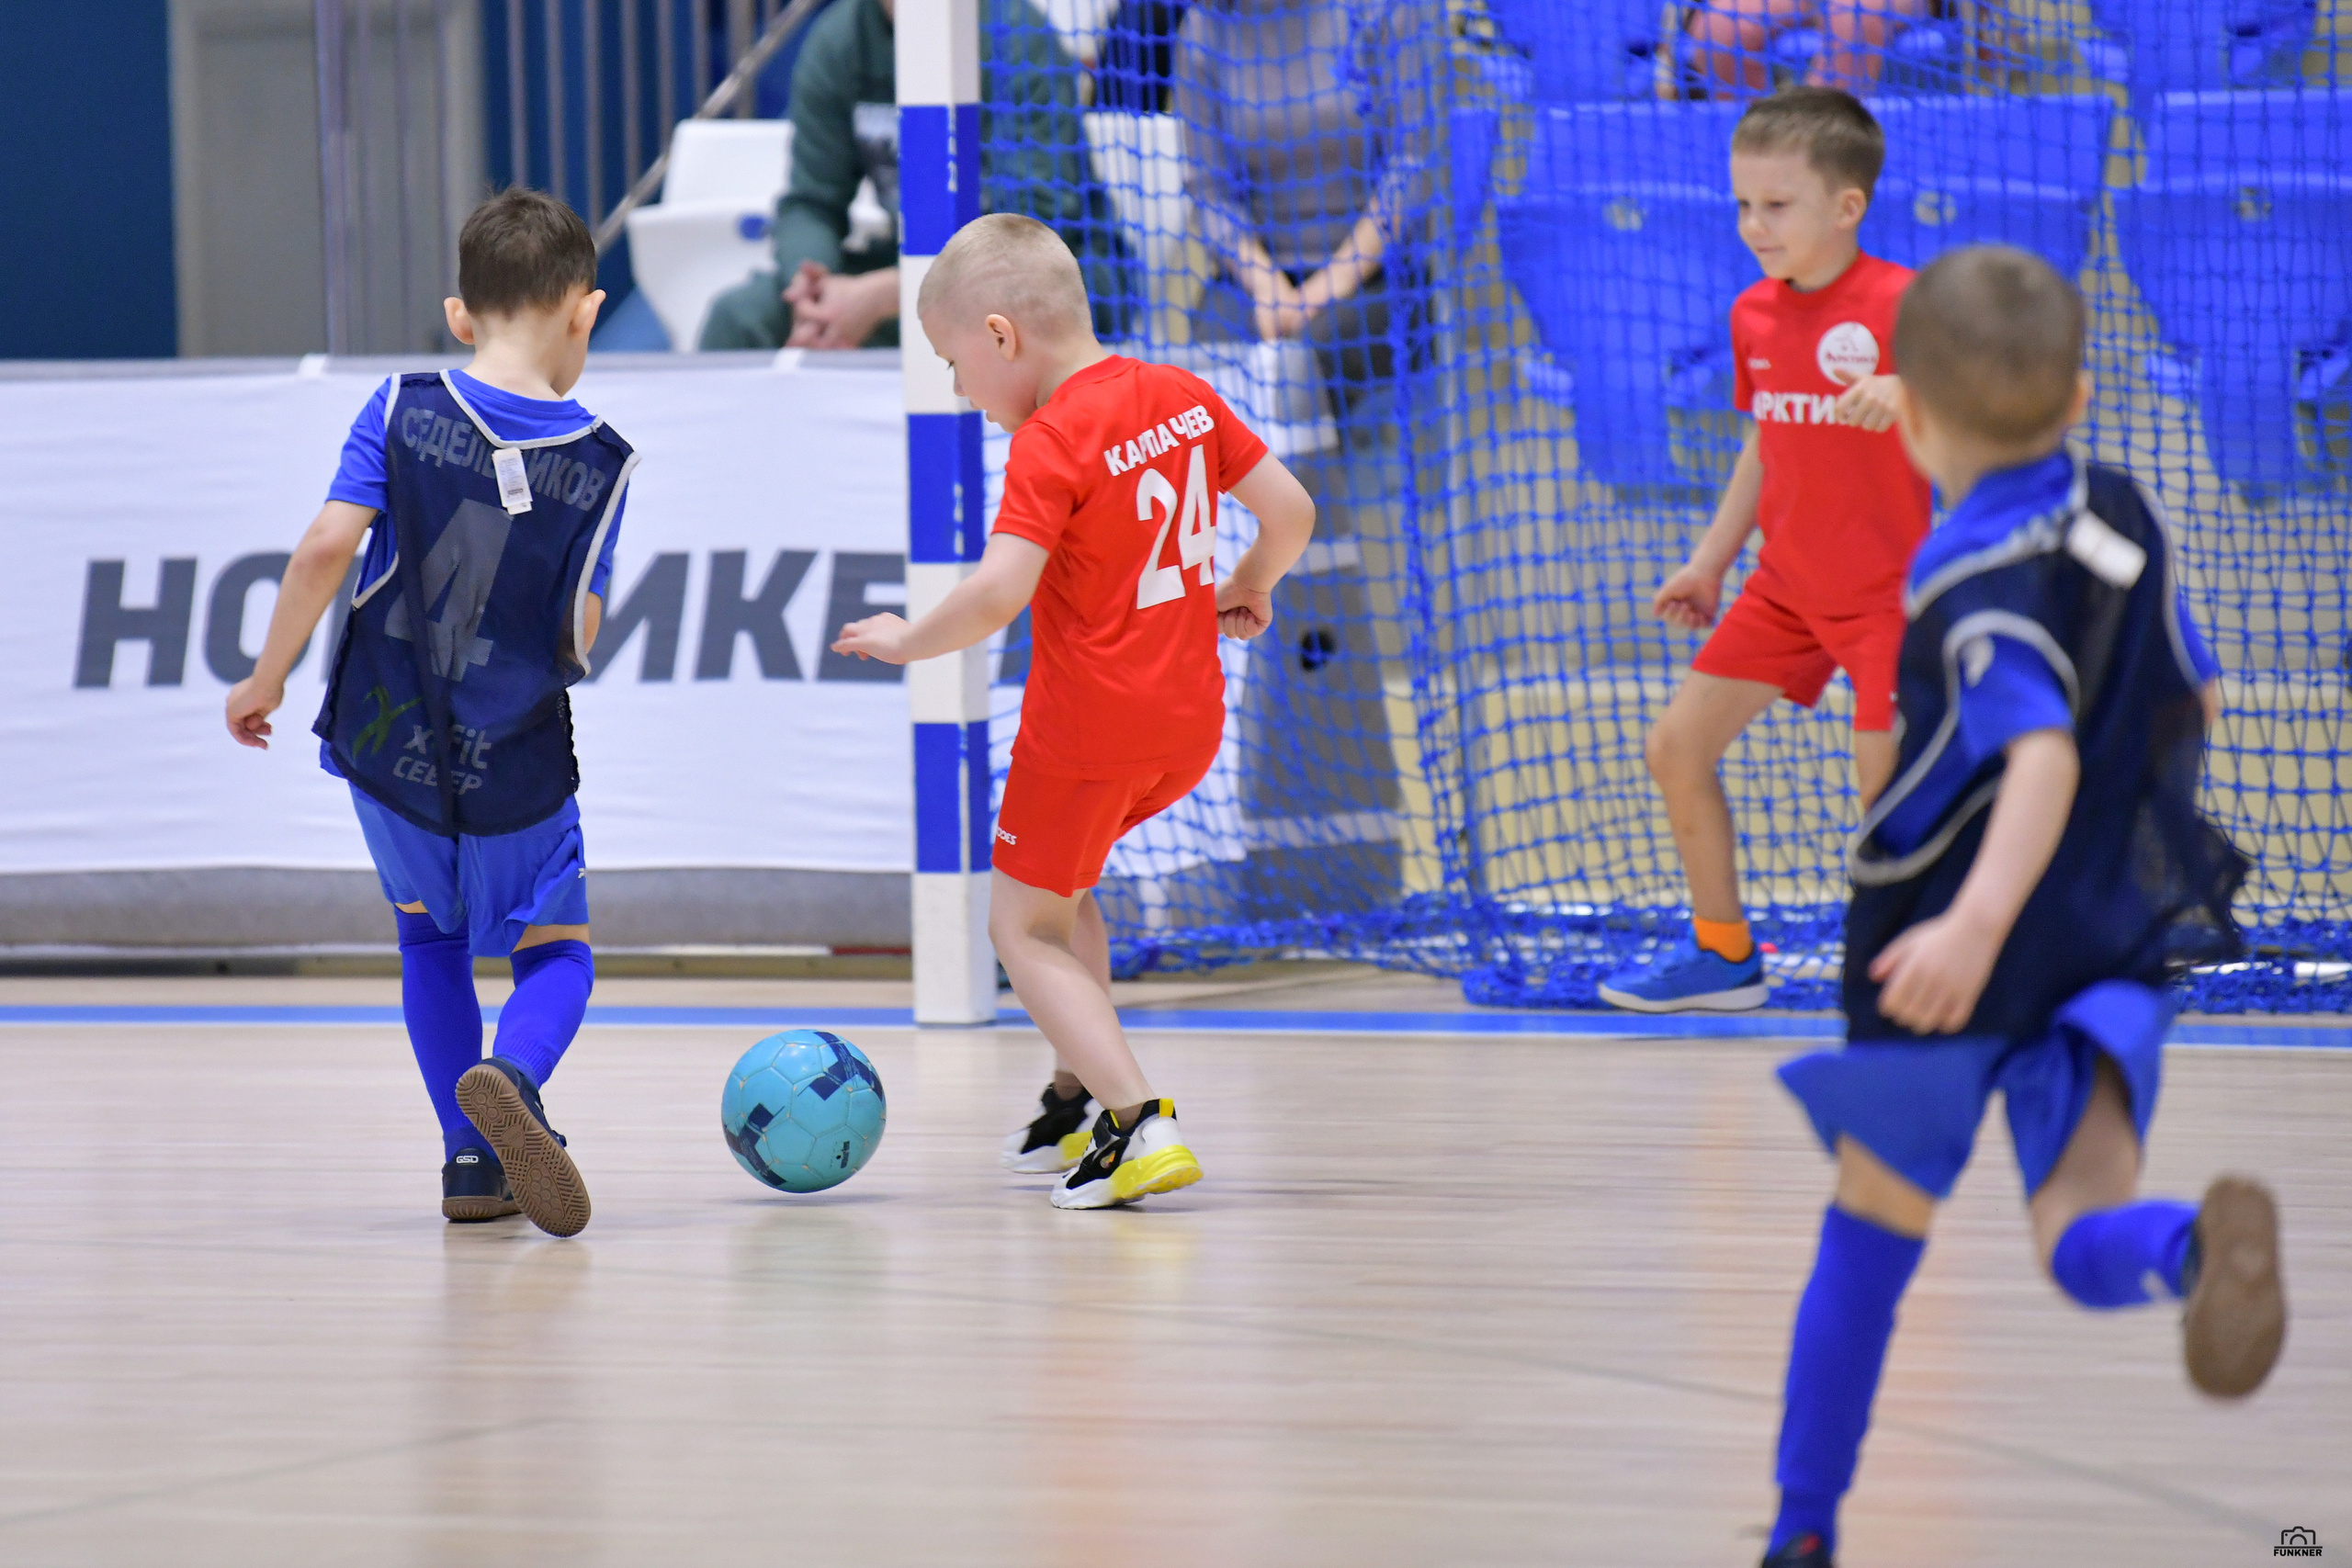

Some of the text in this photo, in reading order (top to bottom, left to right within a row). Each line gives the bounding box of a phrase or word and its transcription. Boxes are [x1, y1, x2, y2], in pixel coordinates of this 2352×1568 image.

[401, 406, 606, 512] СЕДЕЛЬИКОВ
[1752, 390, 1838, 424] РКТИ
[1136, 444, 1216, 609] 24
[384, 498, 514, 682] 4
[456, 1156, 479, 1164] GSD
